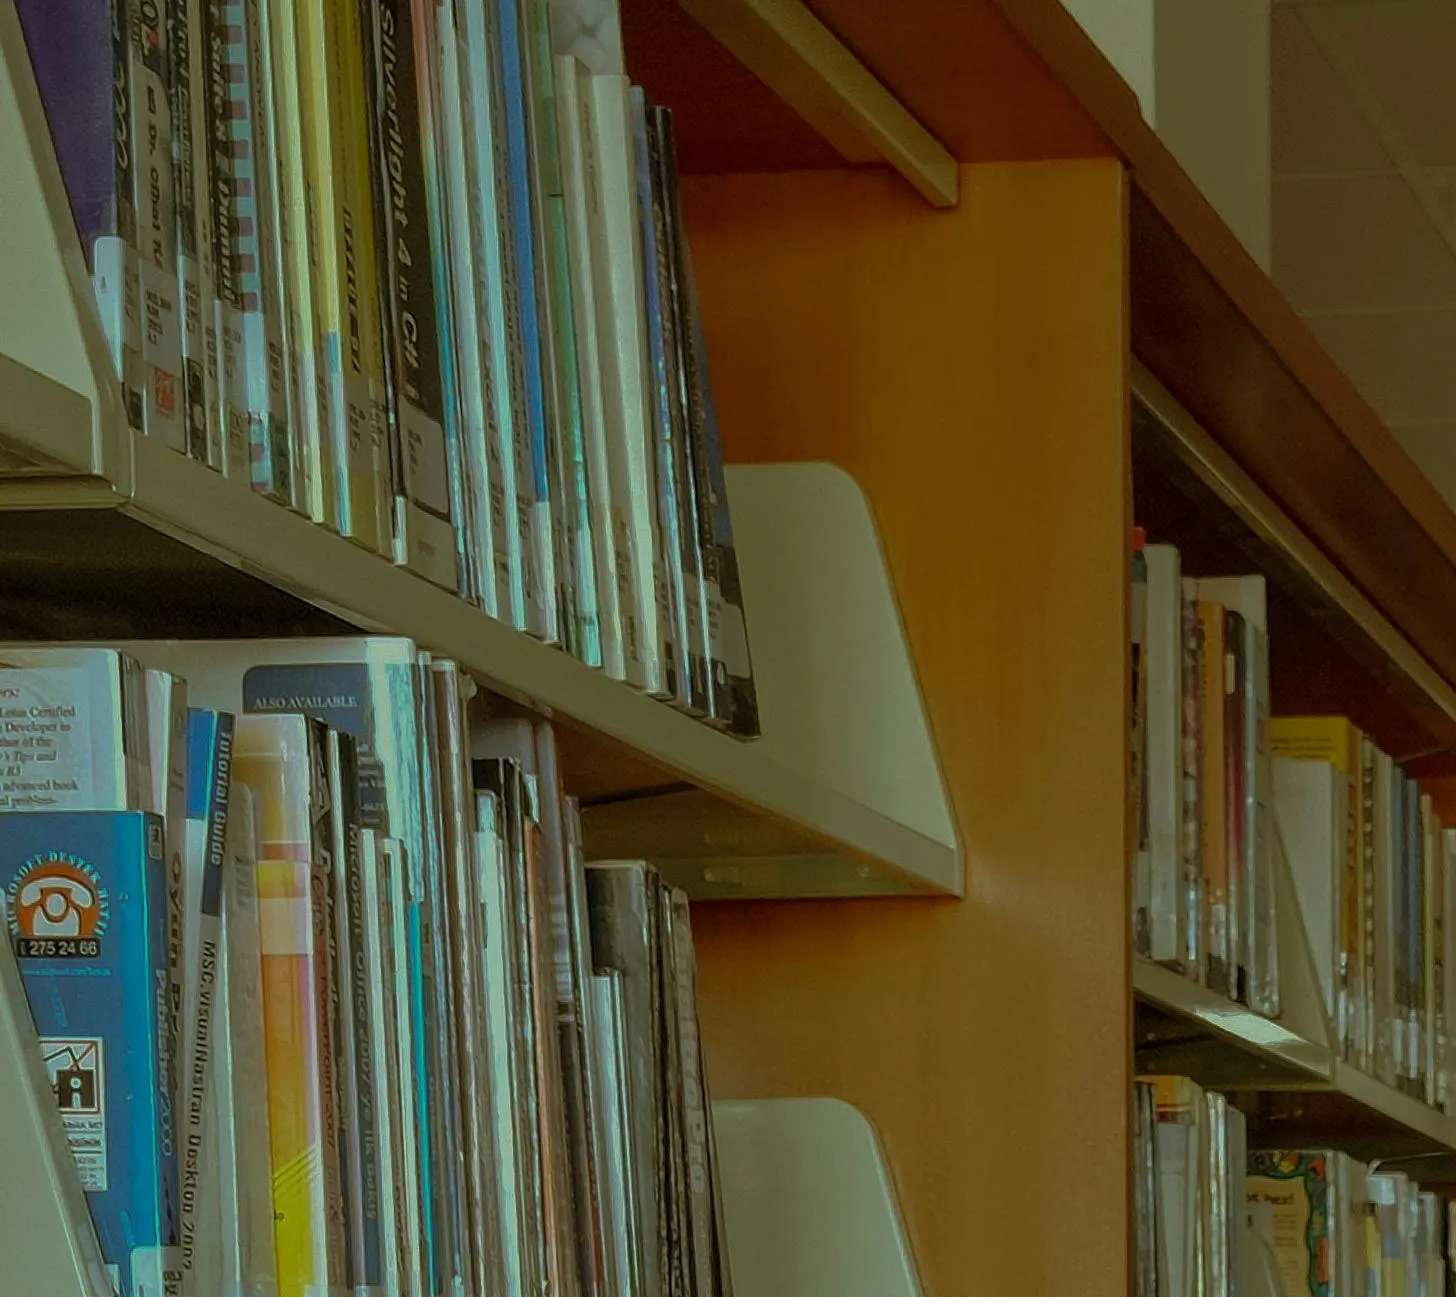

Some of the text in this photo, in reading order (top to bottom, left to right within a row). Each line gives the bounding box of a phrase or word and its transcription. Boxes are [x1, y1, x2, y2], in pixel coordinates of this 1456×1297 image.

[380, 8, 409, 228] Silverlight
[398, 238, 412, 268] 4
[397, 277, 409, 303] in
[255, 696, 358, 709] ALSO AVAILABLE
[210, 731, 232, 866] Tutorial Guide
[347, 824, 363, 934] Microsoft
[28, 941, 56, 956] 275
[59, 941, 77, 956] 24
[155, 968, 173, 1157] Publisher 2000
